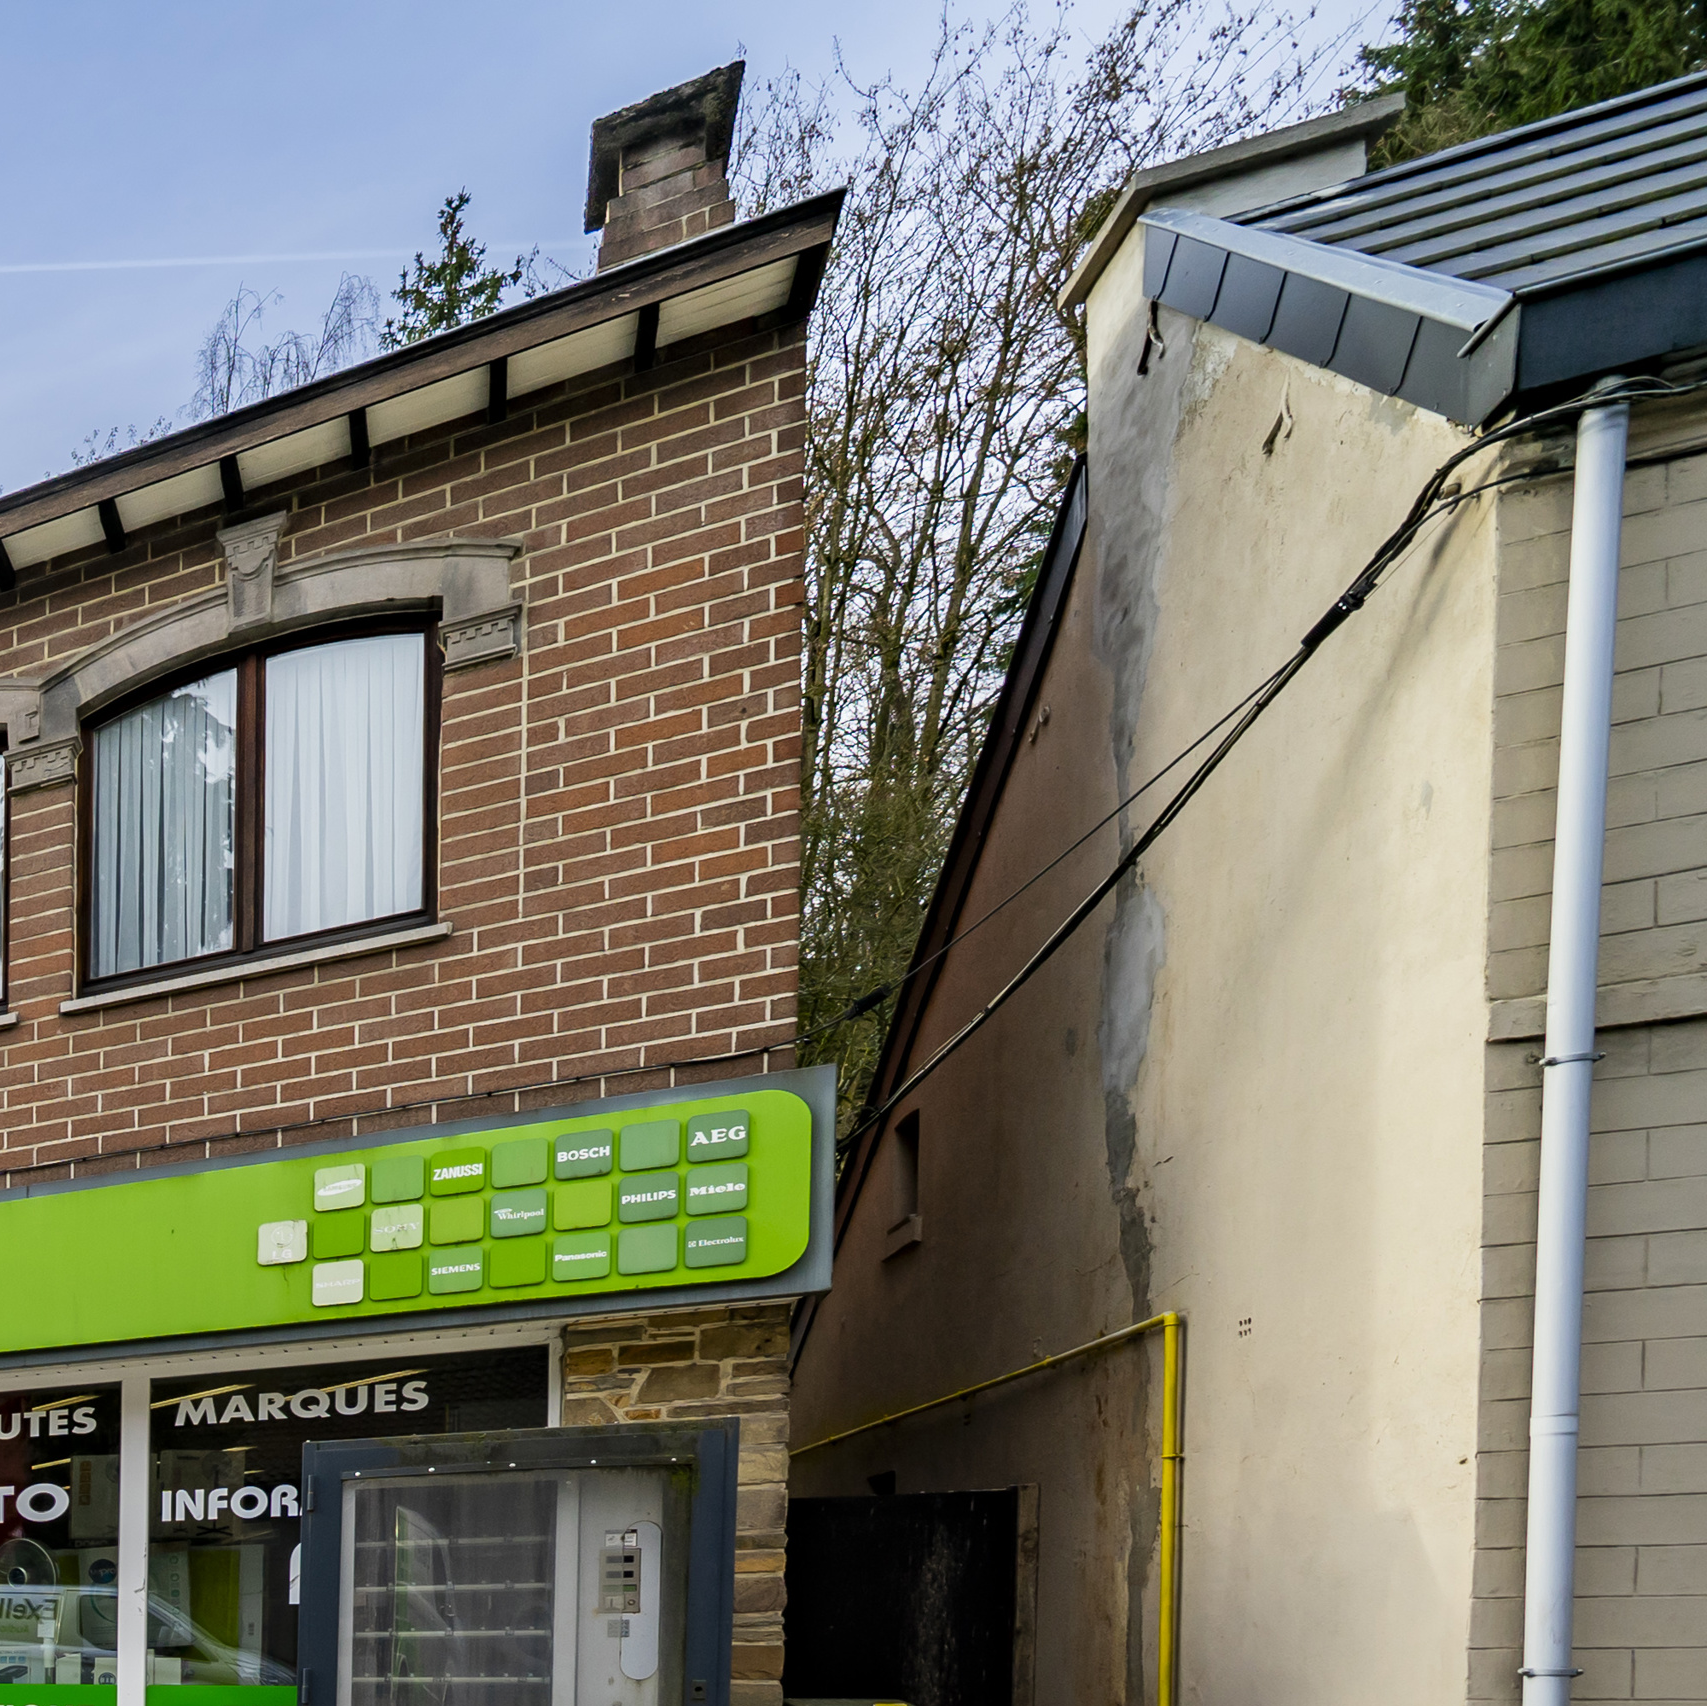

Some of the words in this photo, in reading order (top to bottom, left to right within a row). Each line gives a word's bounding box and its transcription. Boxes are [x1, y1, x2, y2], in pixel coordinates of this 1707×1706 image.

[690, 1125, 747, 1147] AEG
[557, 1145, 610, 1162] BOSCH
[433, 1163, 483, 1181] ZANUSSI
[621, 1189, 676, 1205] PHILIPS
[689, 1182, 746, 1197] Miele
[496, 1208, 545, 1221] Whirlpool
[373, 1222, 420, 1234] SONY
[698, 1236, 744, 1247] Electrolux
[554, 1250, 607, 1262] Panasonic
[431, 1262, 480, 1276] SIEMENS
[315, 1278, 361, 1289] SHARP
[174, 1381, 429, 1427] MARQUES
[161, 1484, 302, 1523] INFOR
